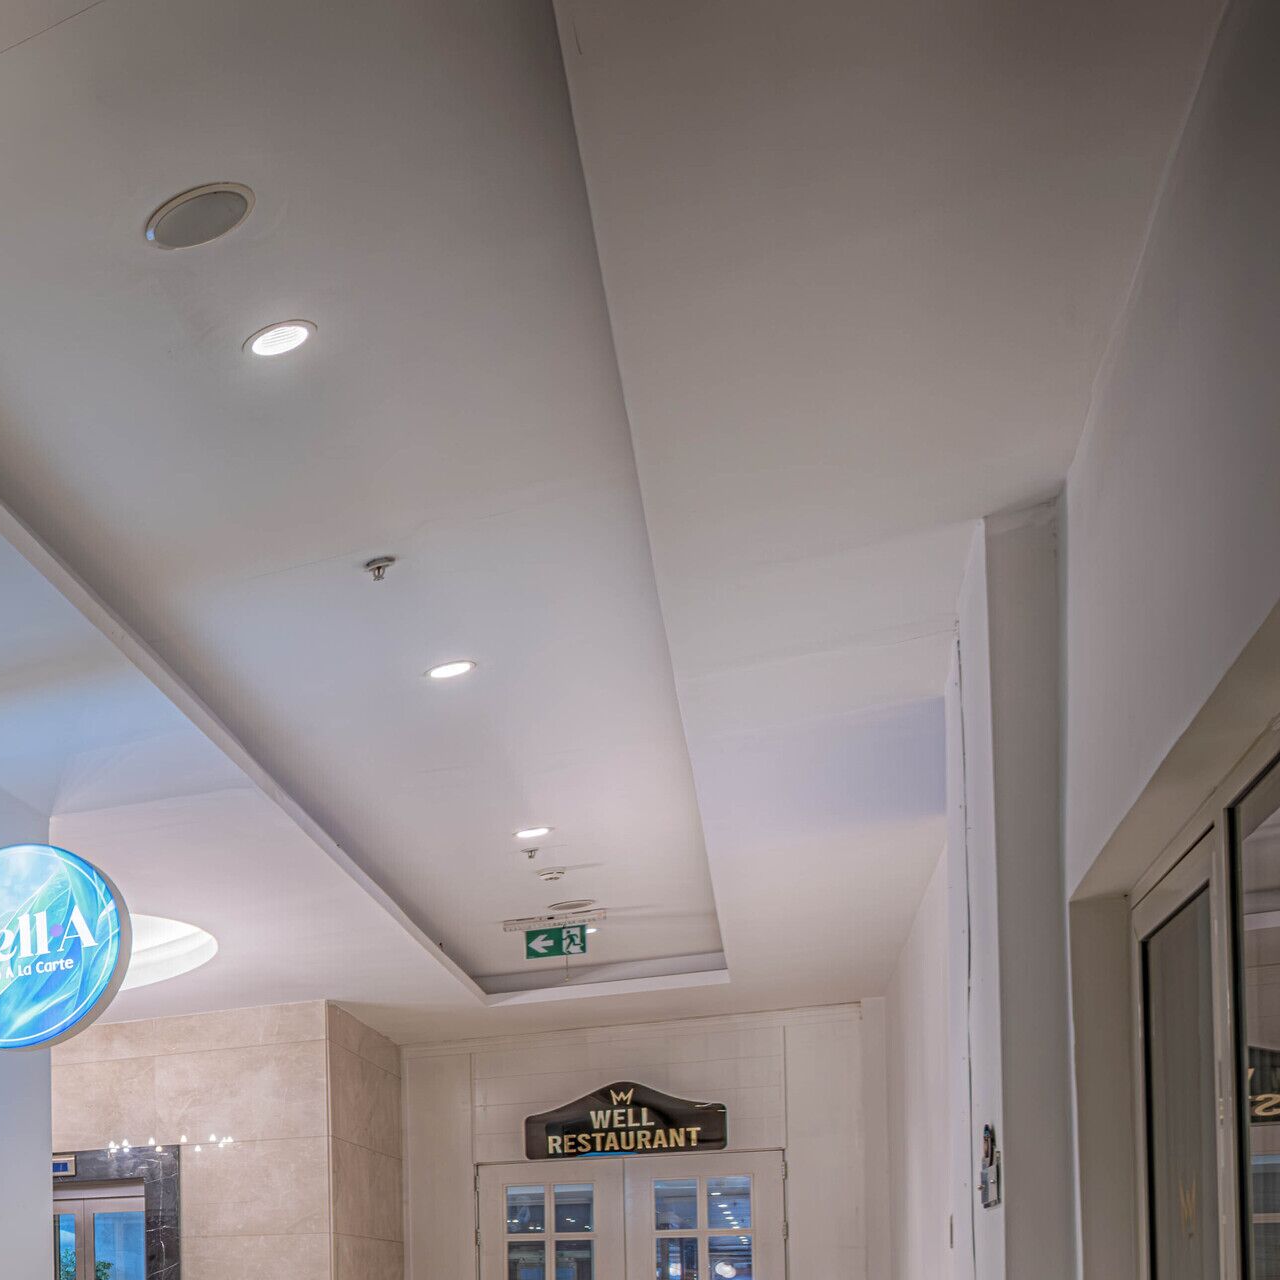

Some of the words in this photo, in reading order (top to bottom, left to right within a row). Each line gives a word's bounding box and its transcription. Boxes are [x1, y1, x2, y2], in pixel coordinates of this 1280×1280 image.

[17, 963, 32, 977] La
[35, 957, 75, 975] Carte
[589, 1107, 656, 1130] WELL
[547, 1126, 702, 1155] RESTAURANT
